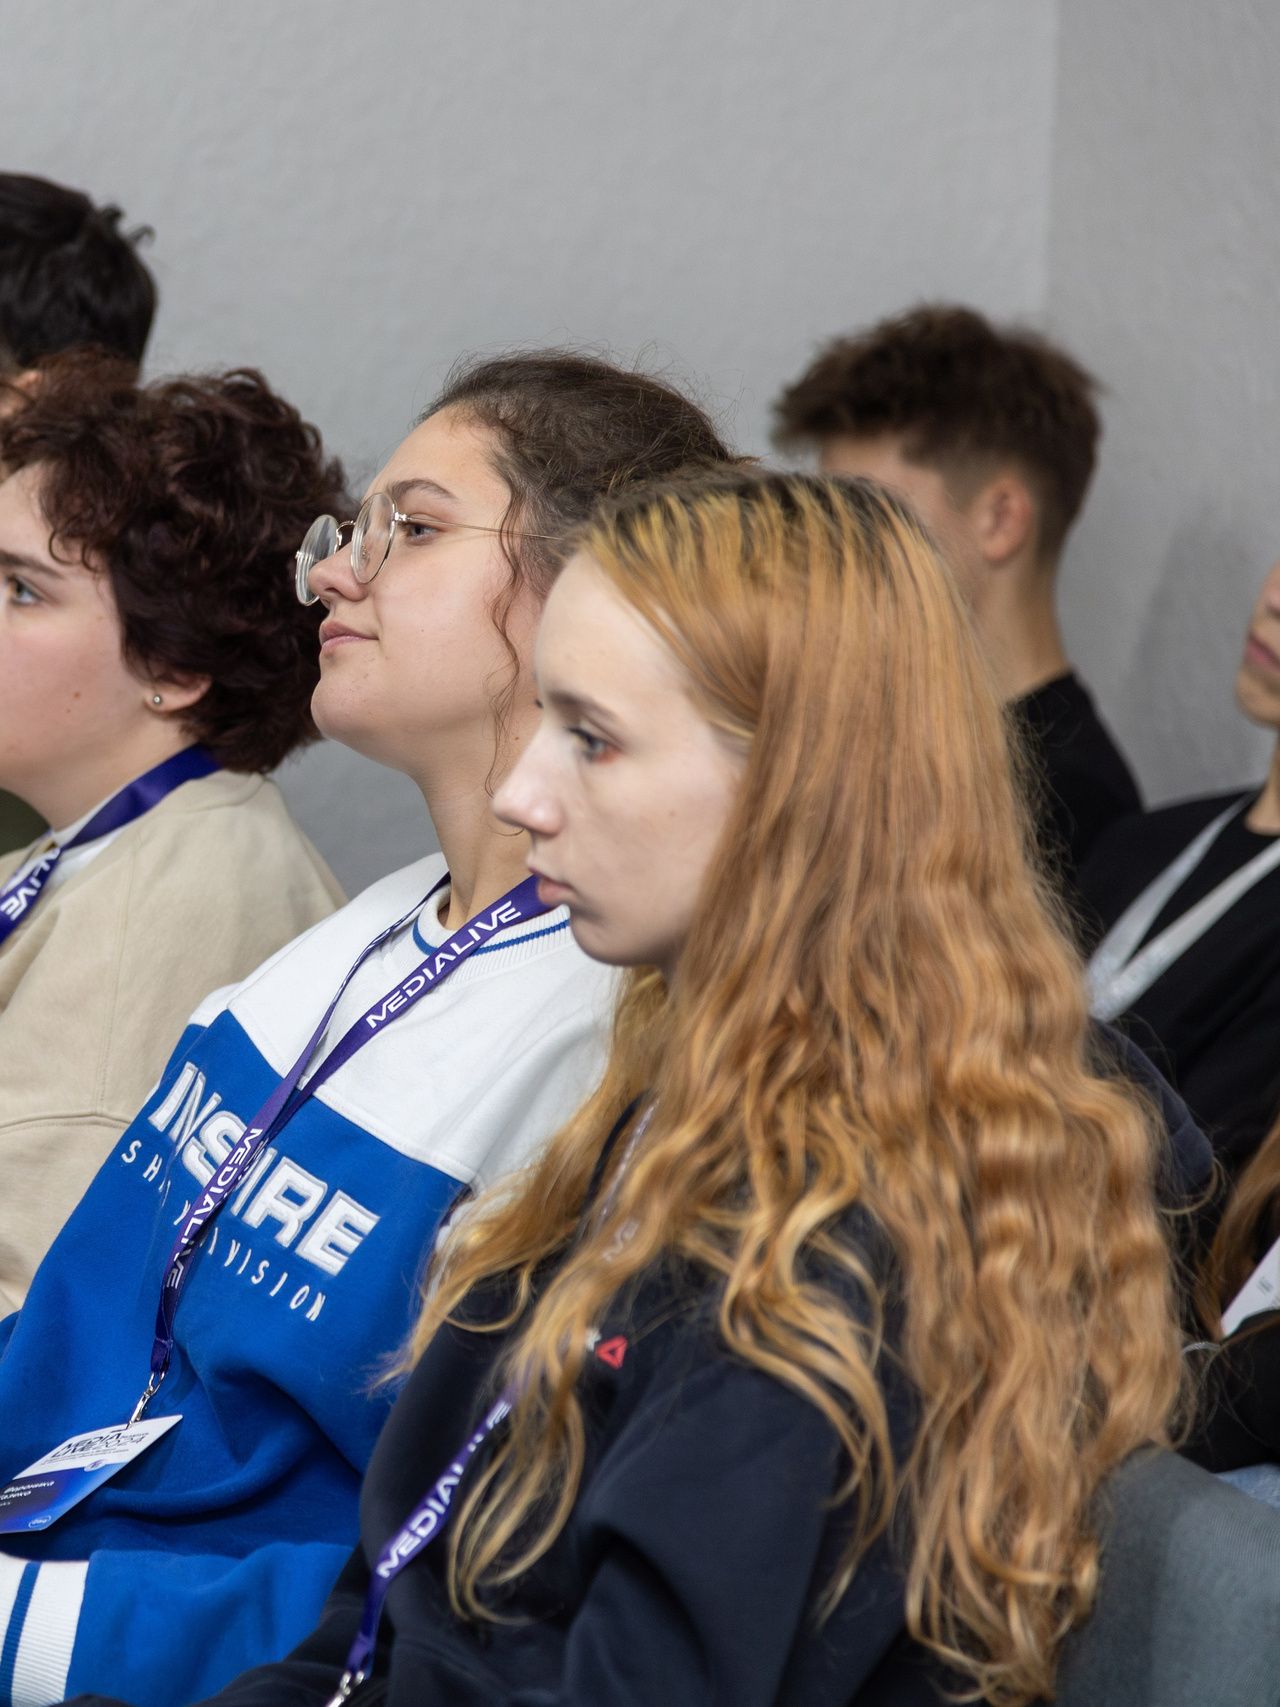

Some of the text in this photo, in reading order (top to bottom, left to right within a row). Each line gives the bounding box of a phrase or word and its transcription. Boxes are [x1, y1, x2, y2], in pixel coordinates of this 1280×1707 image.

[366, 900, 522, 1029] MEDIALIVE
[148, 1061, 381, 1277] INSIRE
[198, 1227, 326, 1321] IVISION
